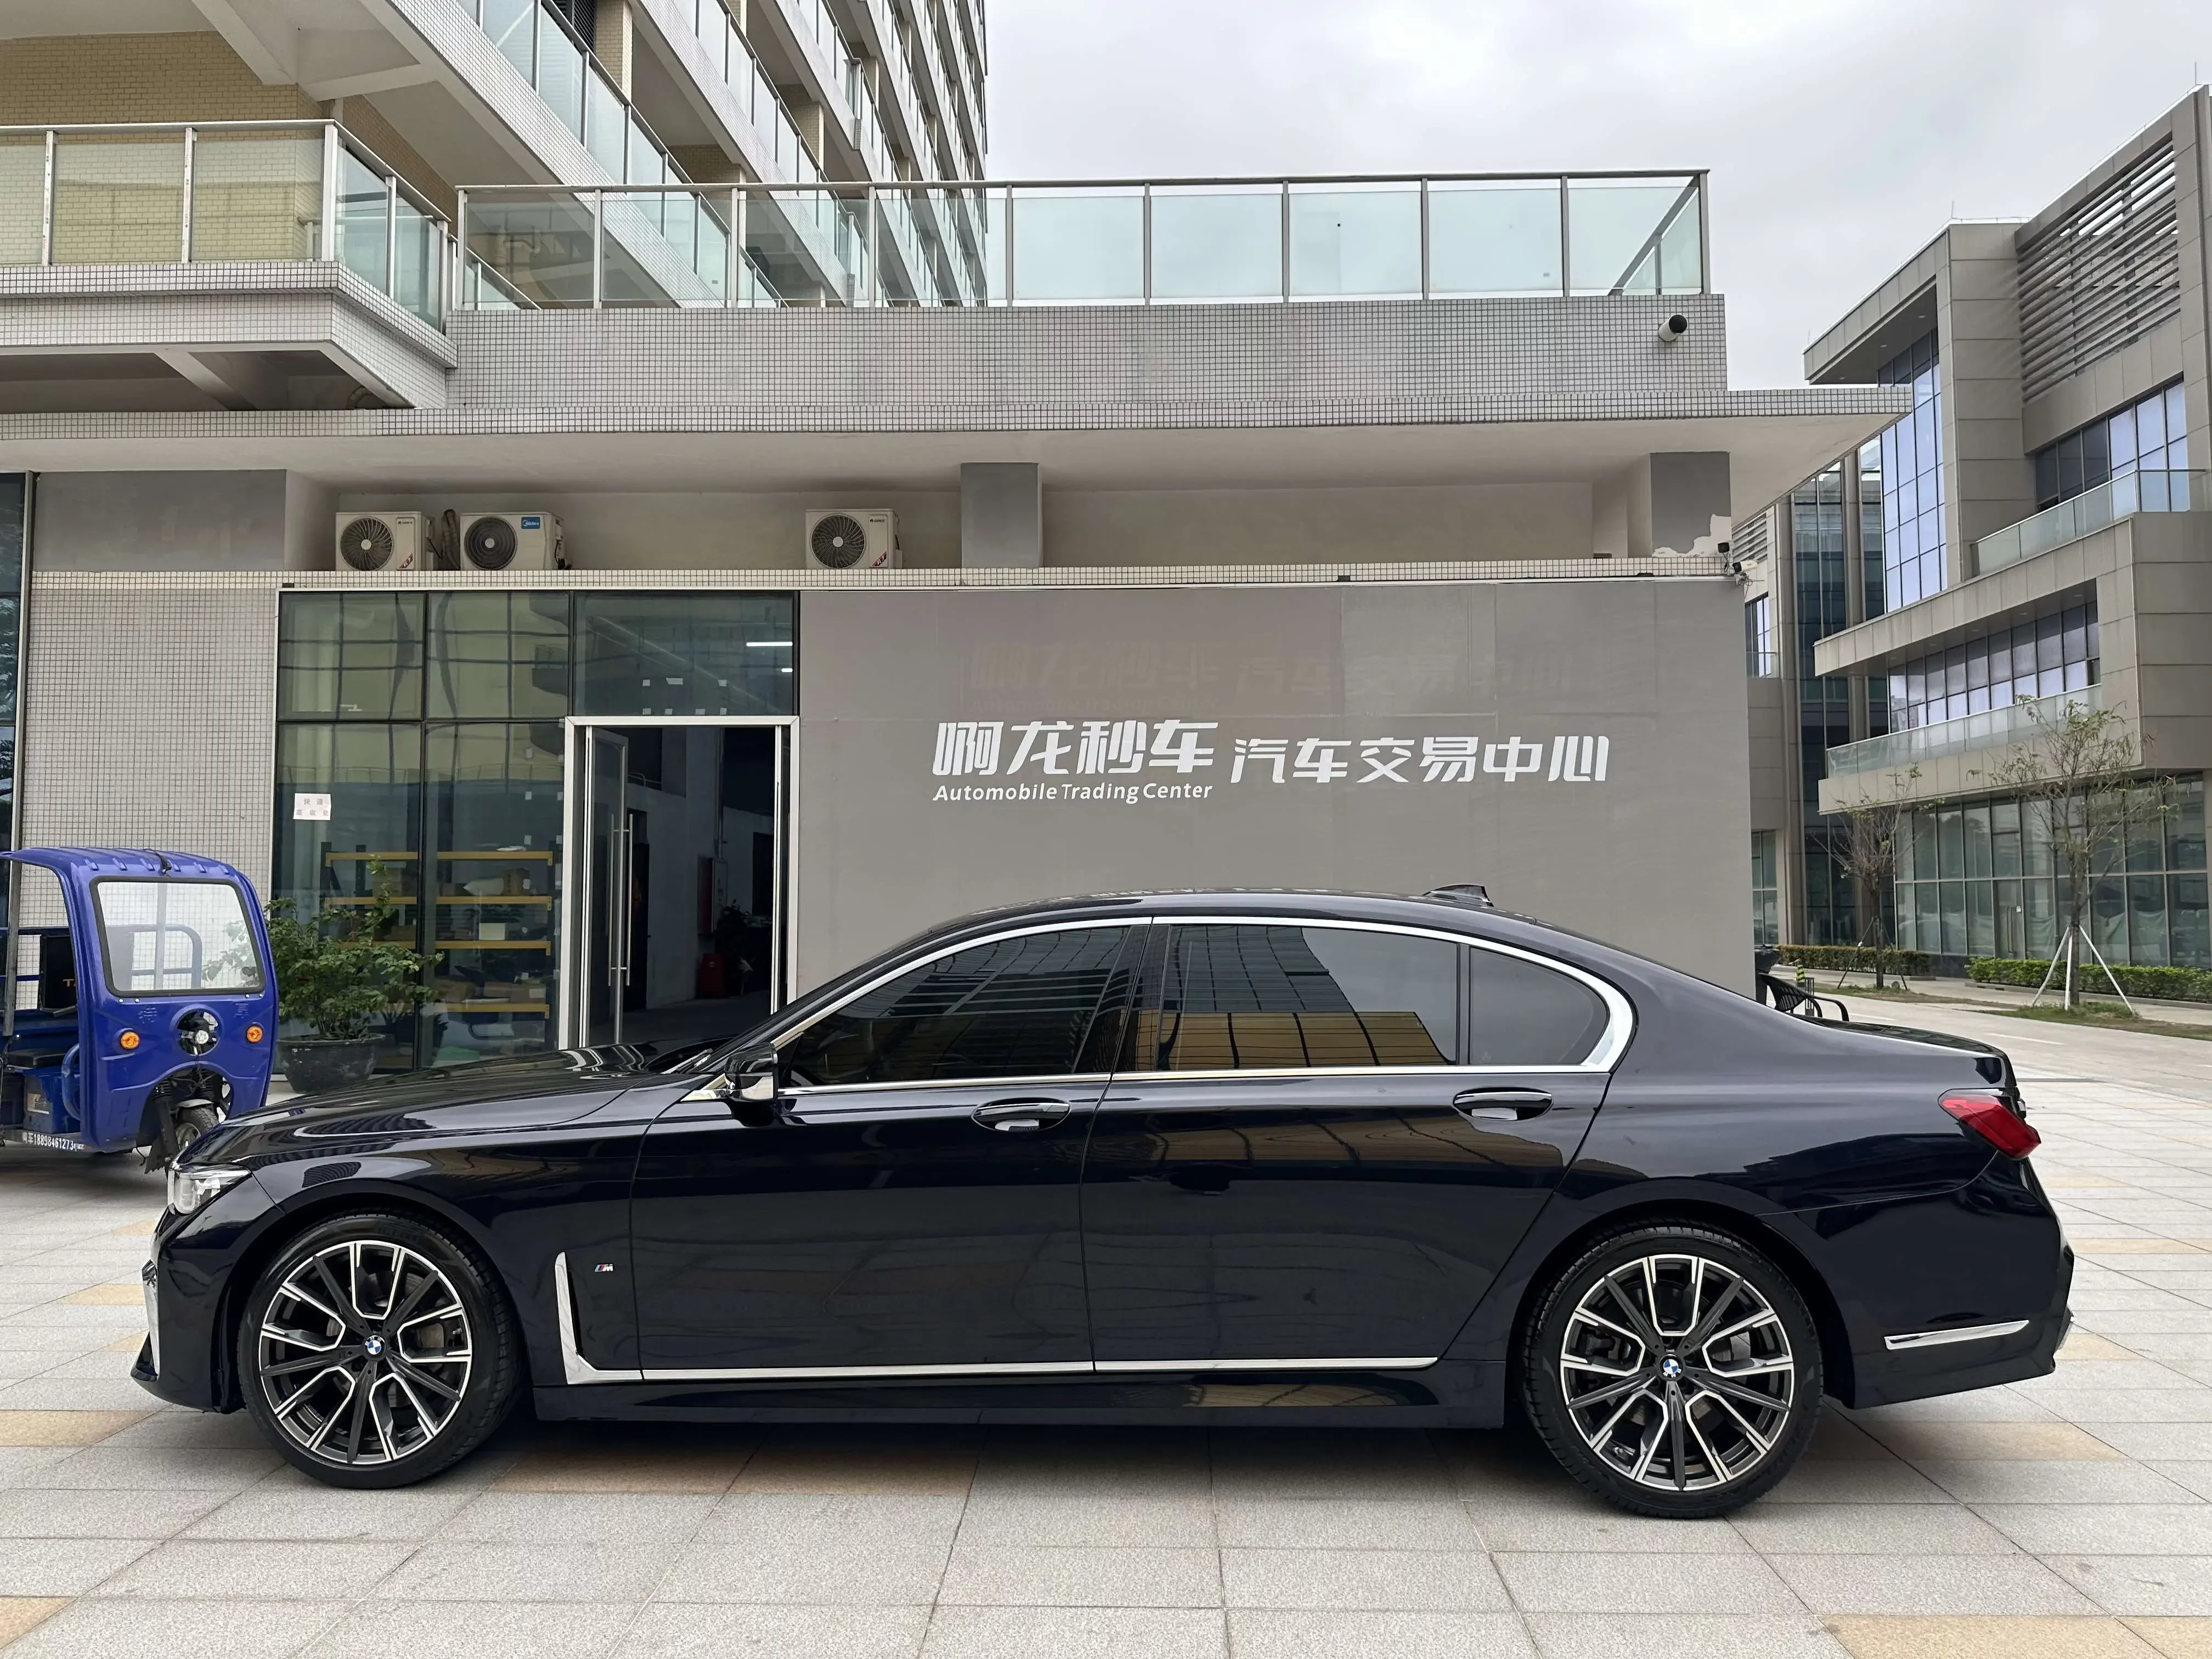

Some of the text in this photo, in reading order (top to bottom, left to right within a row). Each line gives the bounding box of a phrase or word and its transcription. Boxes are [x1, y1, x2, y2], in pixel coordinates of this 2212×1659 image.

[932, 719, 1609, 783] 啊龙秒车 汽车交易中心
[932, 782, 1212, 804] Automobile Trading Center
